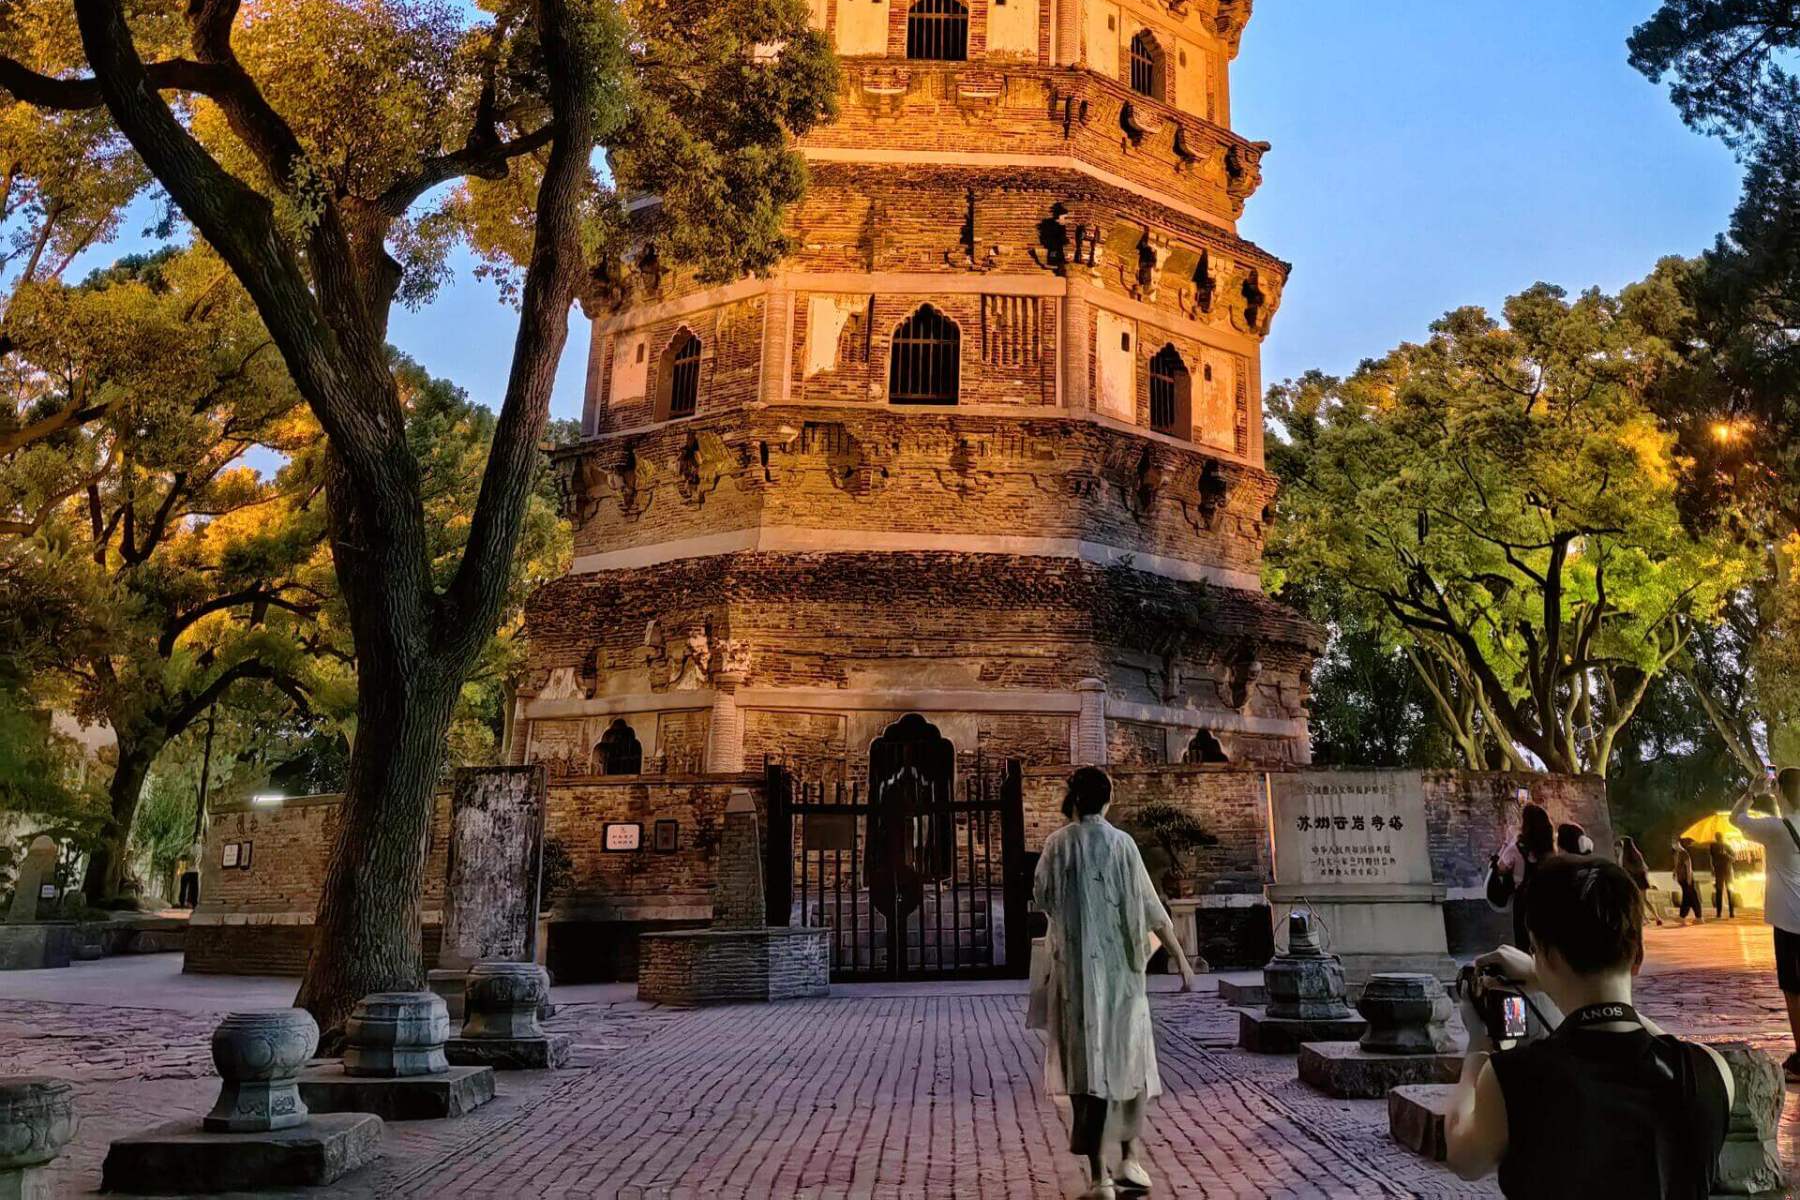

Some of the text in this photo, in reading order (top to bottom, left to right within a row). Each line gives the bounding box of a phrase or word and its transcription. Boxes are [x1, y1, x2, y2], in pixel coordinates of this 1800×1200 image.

[1297, 815, 1404, 832] 苏州云岩寺塔
[1582, 1006, 1624, 1020] SONY
